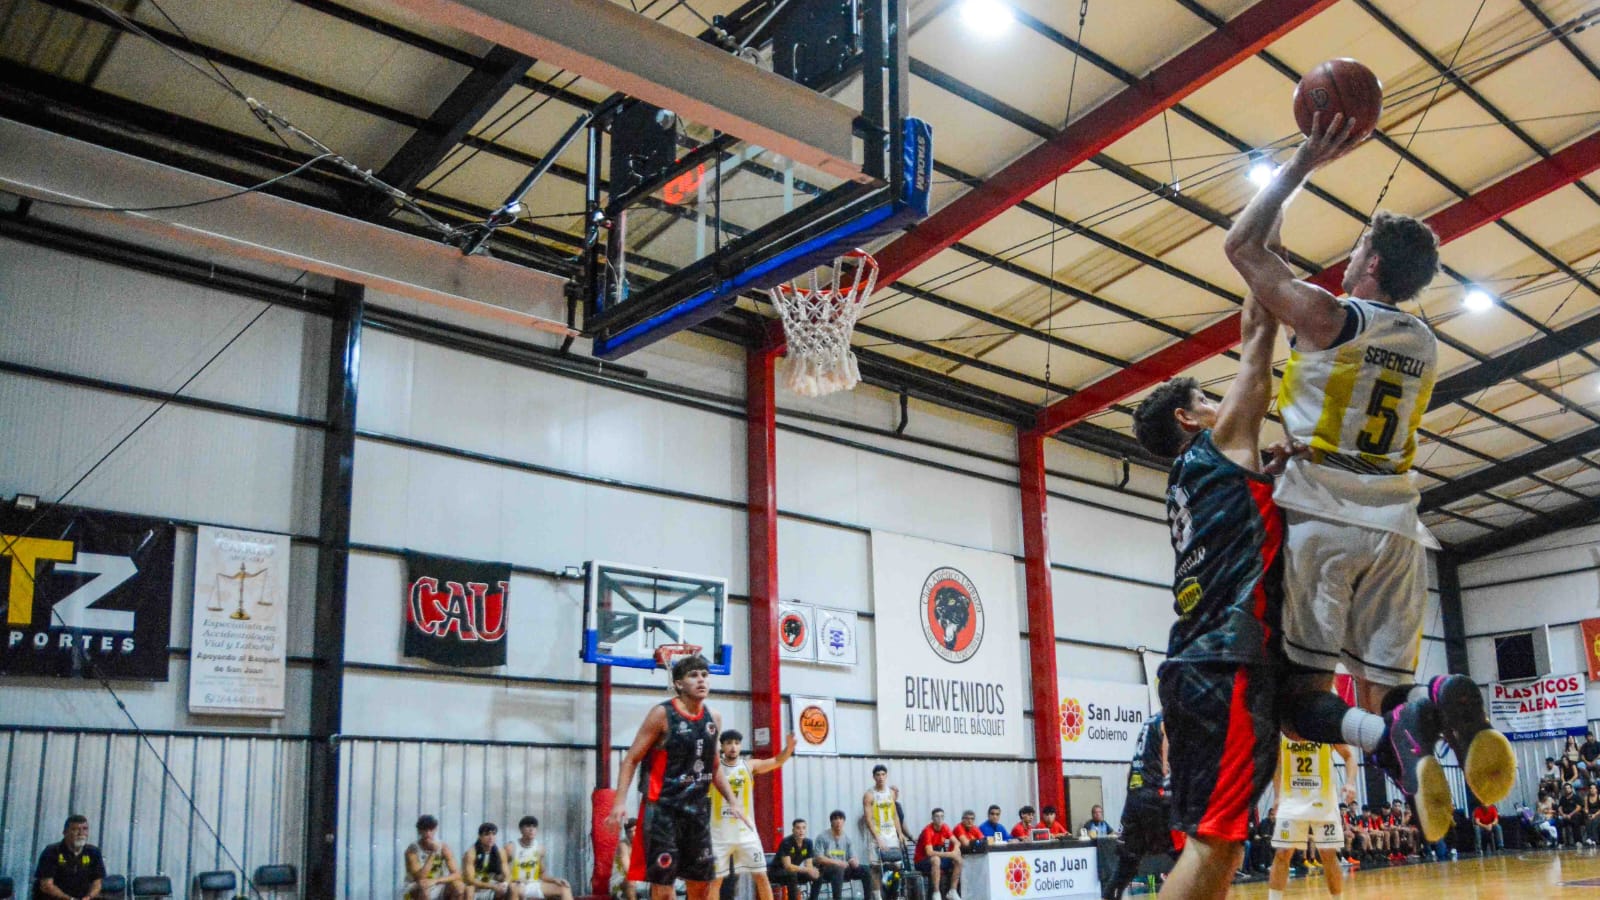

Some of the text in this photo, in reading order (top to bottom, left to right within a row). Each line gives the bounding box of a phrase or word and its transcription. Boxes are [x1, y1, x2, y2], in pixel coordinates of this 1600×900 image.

[1364, 345, 1425, 378] SERENELLI
[1356, 379, 1403, 455] 5
[411, 576, 509, 641] CAU
[905, 675, 1005, 715] BIENVENIDOS
[1495, 677, 1579, 699] PLASTICOS
[1087, 703, 1142, 723] San Juan
[1519, 696, 1558, 713] ALEM
[905, 713, 916, 732] AL
[919, 714, 951, 734] TEMPLO
[953, 716, 968, 735] DEL
[1087, 725, 1128, 741] Gobierno
[1296, 756, 1313, 773] 22
[1323, 824, 1336, 836] 22
[1034, 856, 1088, 873] San Juan
[1034, 877, 1074, 892] Gobierno
